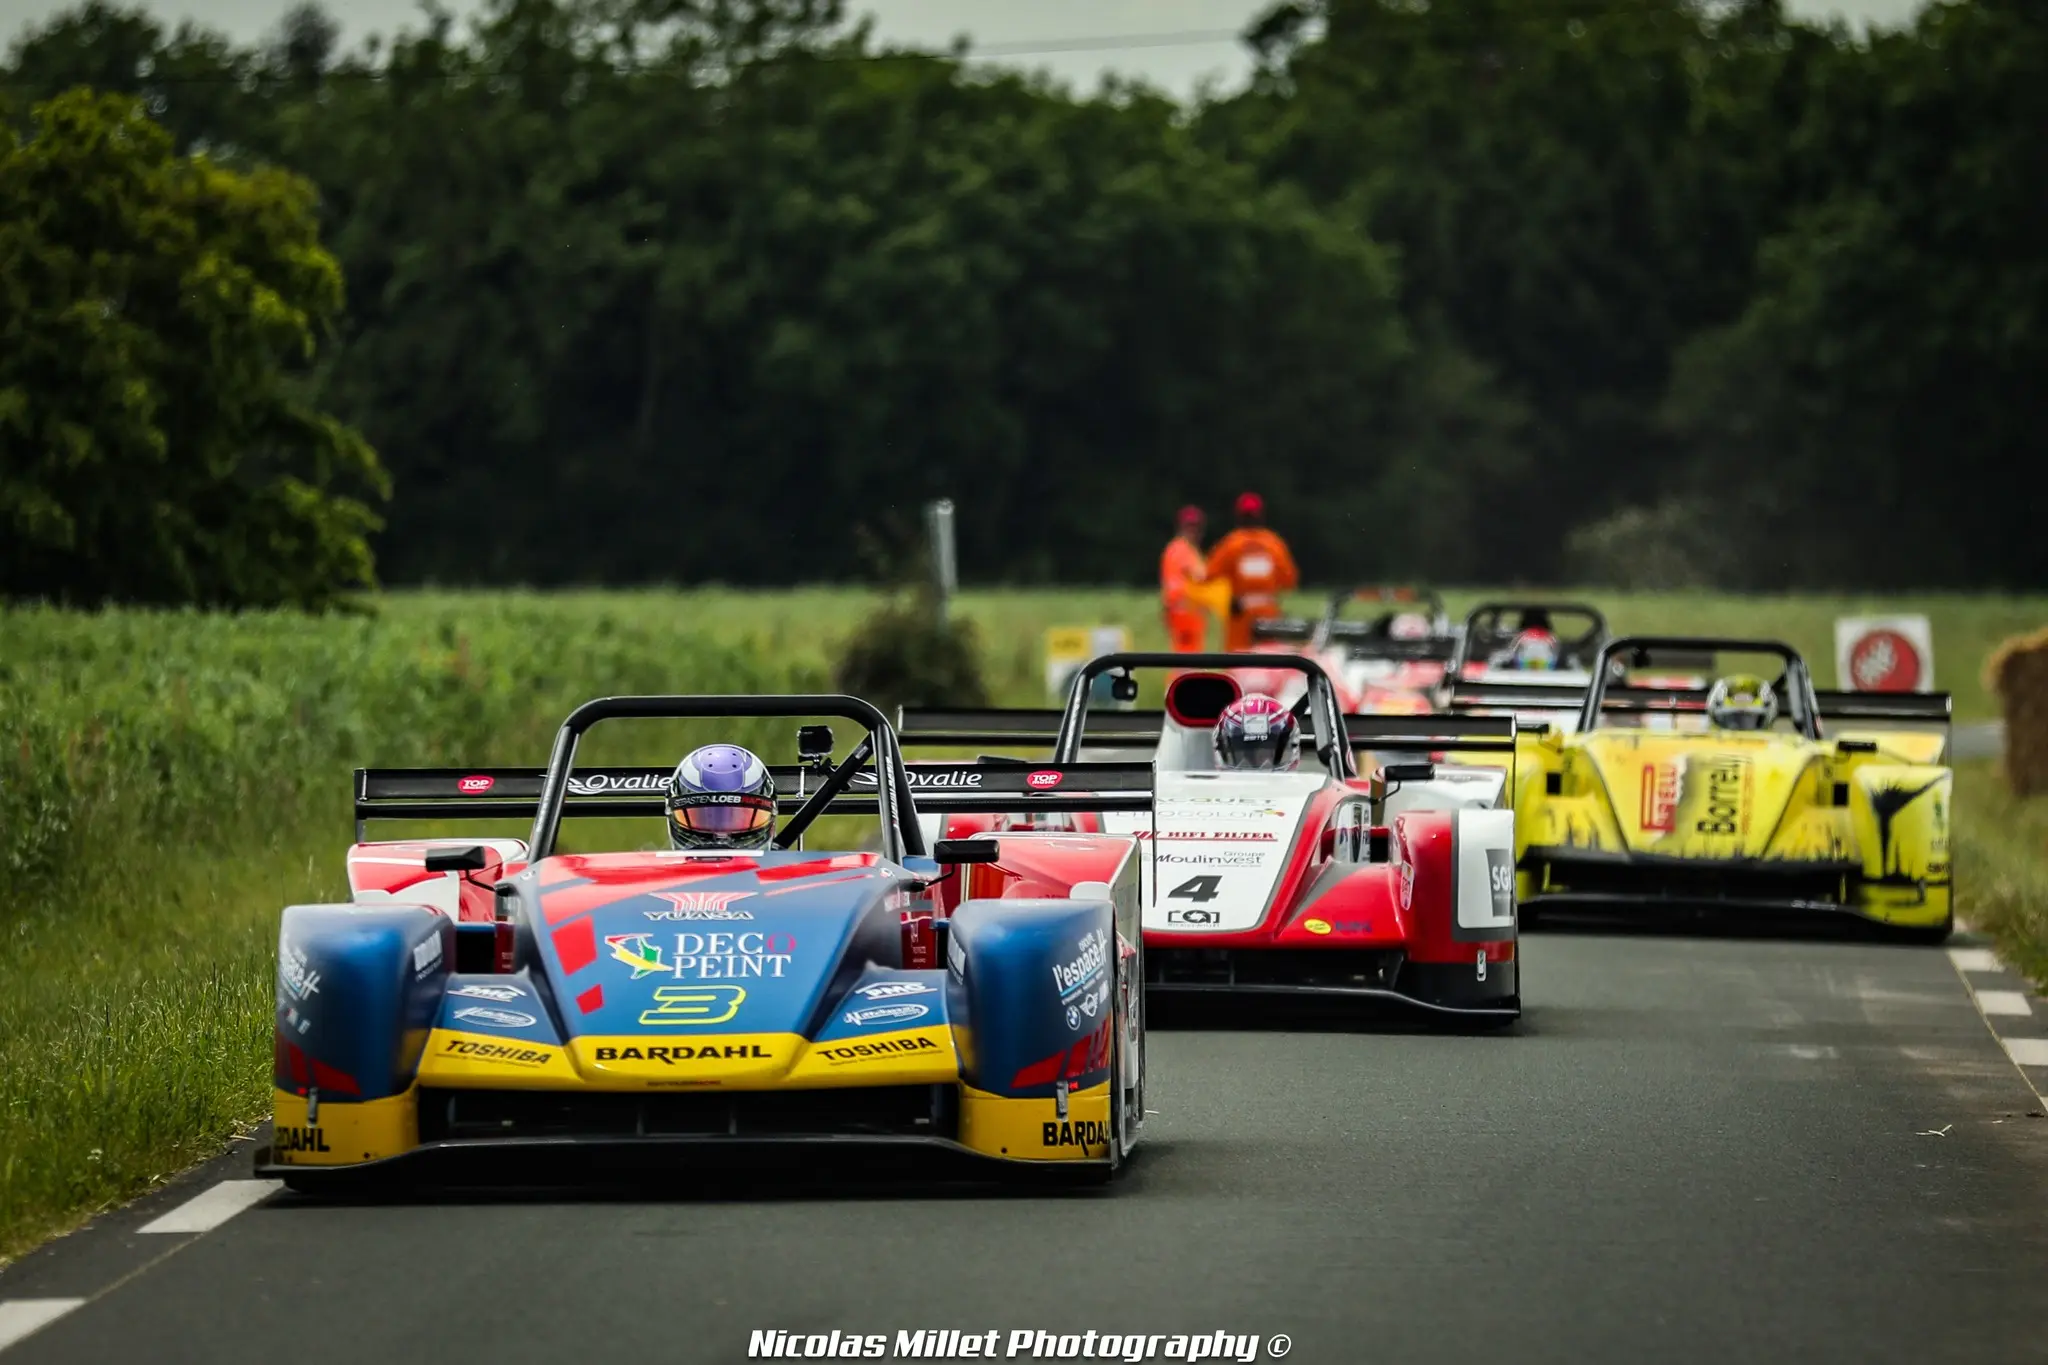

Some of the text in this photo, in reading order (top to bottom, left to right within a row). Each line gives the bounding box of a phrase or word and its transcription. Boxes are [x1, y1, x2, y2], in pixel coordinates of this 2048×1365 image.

[463, 779, 490, 787] TOP
[586, 774, 672, 790] Ovalie
[1033, 774, 1058, 782] TOP
[1156, 854, 1262, 864] Moulinvest
[1168, 875, 1223, 902] 4
[644, 911, 755, 921] YUASA
[674, 932, 797, 956] DECO
[672, 955, 792, 979] PEINT
[638, 984, 747, 1025] 3
[445, 1040, 552, 1064] TOSHIBA
[595, 1045, 772, 1065] BARDAHL
[816, 1037, 938, 1060] TOSHIBA
